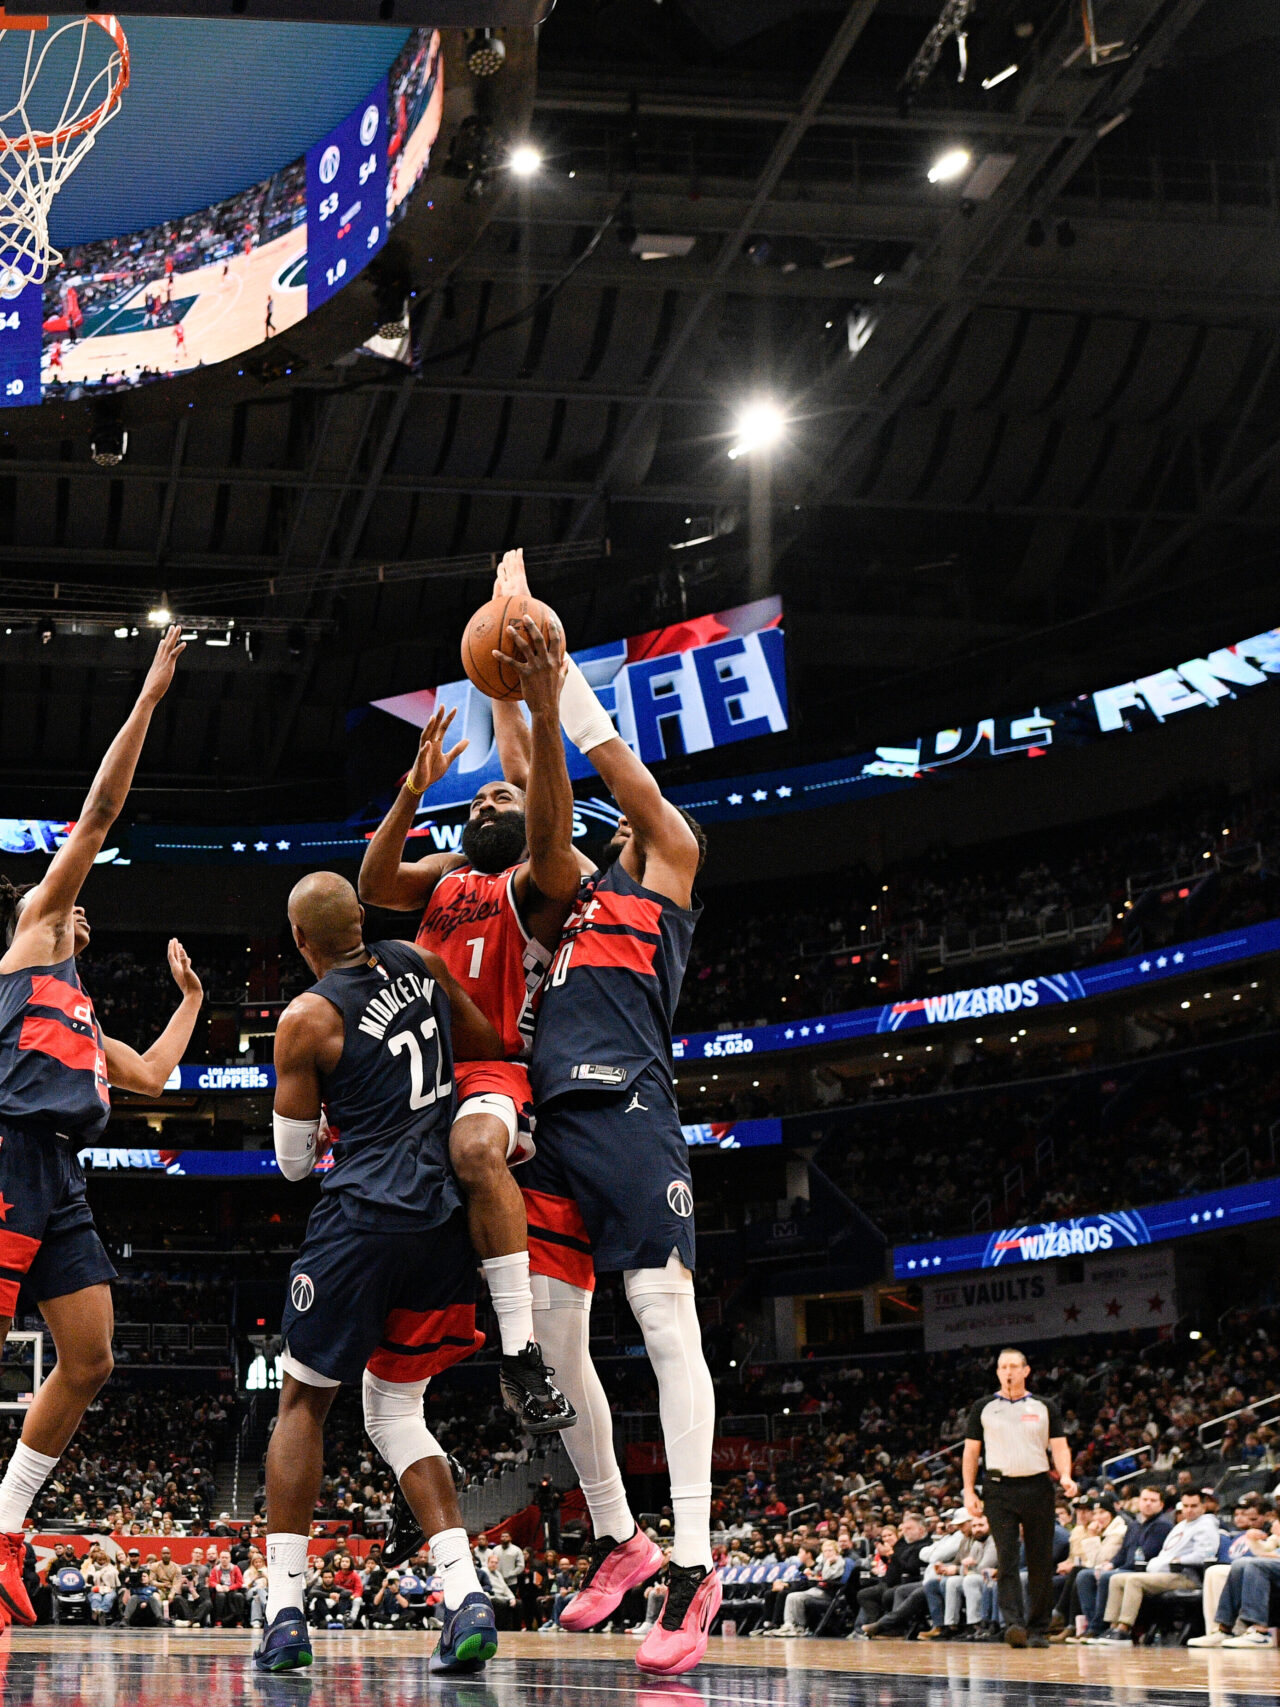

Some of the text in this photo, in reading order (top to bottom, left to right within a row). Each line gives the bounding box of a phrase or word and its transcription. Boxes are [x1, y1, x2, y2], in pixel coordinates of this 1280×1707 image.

[359, 153, 377, 185] 54
[319, 192, 339, 222] 53
[326, 258, 347, 286] 1.0
[446, 890, 478, 912] Ls
[418, 898, 502, 942] Angeles
[466, 937, 485, 978] 1
[544, 941, 575, 992] 0
[358, 973, 435, 1041] MIDDLETN
[922, 979, 1039, 1024] WIZARDS
[387, 1016, 452, 1111] 22
[703, 1038, 754, 1057] $5,020
[198, 1074, 269, 1088] CLIPPERS
[208, 1067, 259, 1075] LOS ANGELES
[1019, 1224, 1113, 1261] WIZARDS
[962, 1274, 1046, 1306] VAULTS
